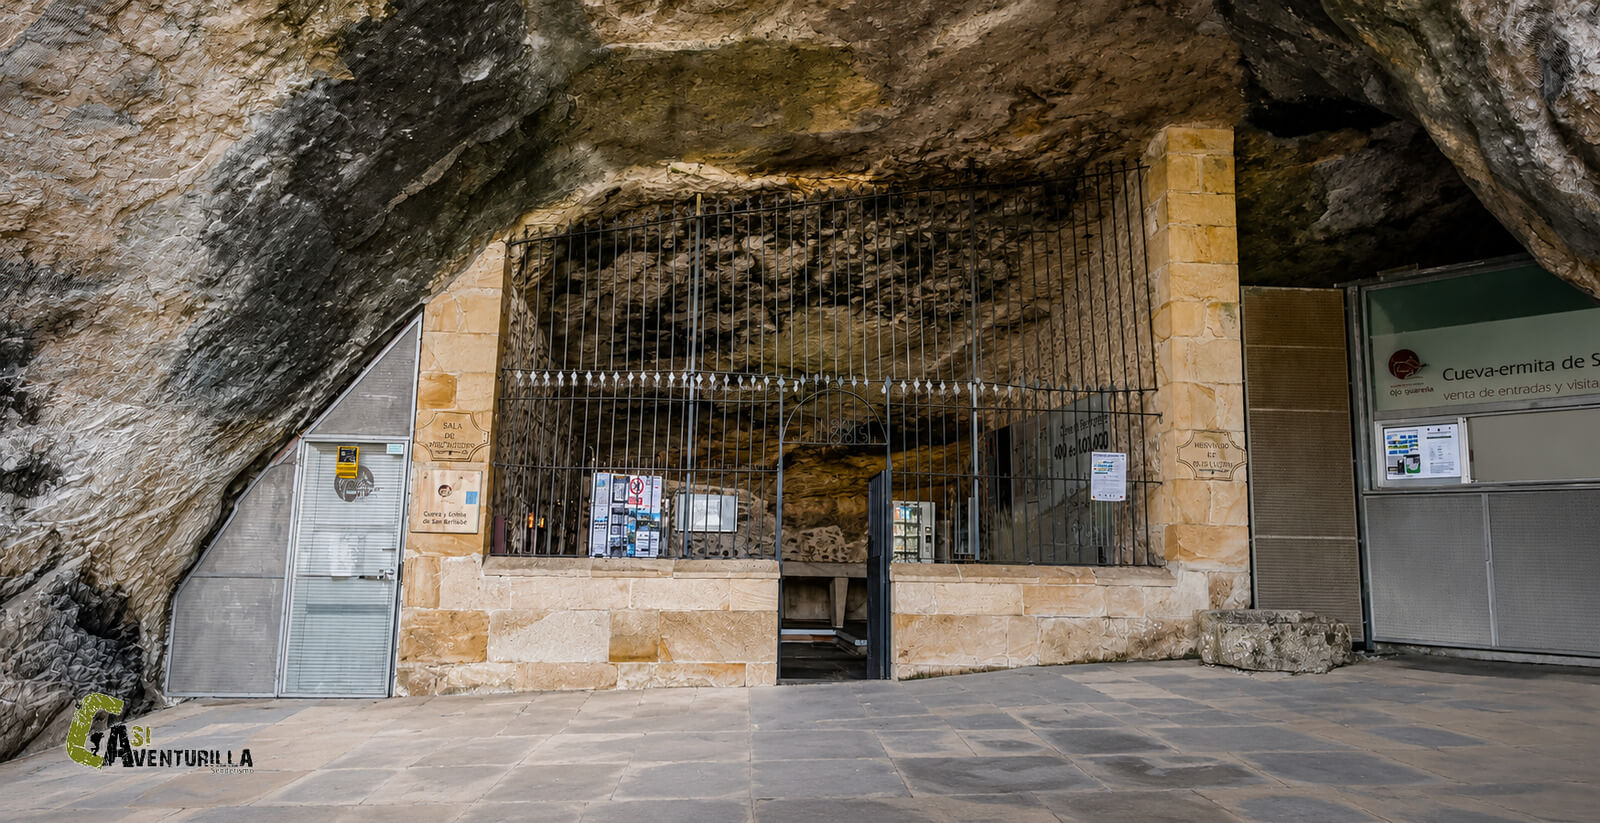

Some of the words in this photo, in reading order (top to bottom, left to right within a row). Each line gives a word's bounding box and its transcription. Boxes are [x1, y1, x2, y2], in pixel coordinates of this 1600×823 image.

[1442, 359, 1555, 381] Cueva-ermita
[1562, 355, 1585, 370] de
[1443, 389, 1476, 401] venta
[1479, 387, 1499, 398] de
[1498, 383, 1552, 397] entradas
[1554, 383, 1563, 394] y
[443, 422, 463, 430] SALA
